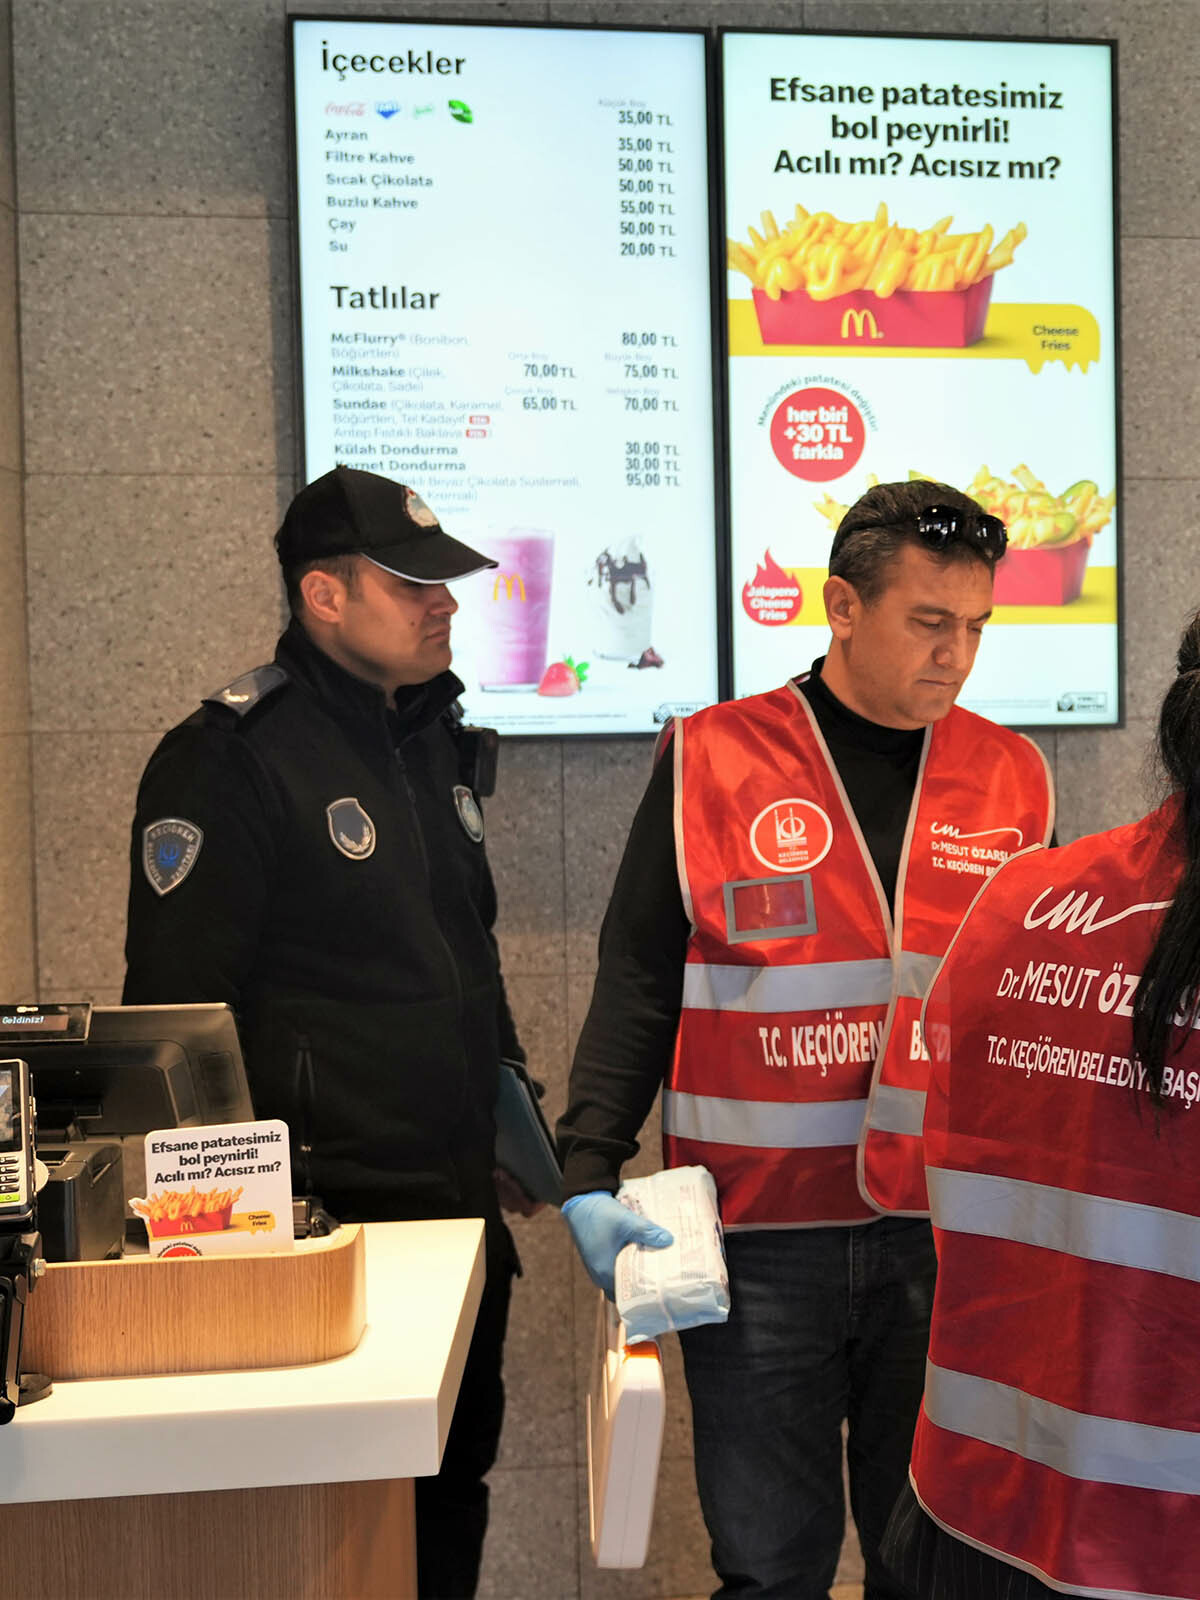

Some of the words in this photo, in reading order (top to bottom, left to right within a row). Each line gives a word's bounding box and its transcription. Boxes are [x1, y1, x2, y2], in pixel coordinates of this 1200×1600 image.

[321, 41, 466, 80] İçecekler
[770, 77, 875, 103] Efsane
[882, 81, 1064, 112] patatesimiz
[618, 110, 653, 127] 35,00
[657, 114, 673, 126] TL
[325, 129, 368, 143] Ayran
[831, 114, 878, 140] bol
[886, 116, 1010, 148] peynirli!
[618, 137, 653, 153] 35,00
[657, 141, 674, 153] TL
[326, 150, 366, 163] Filtre
[369, 151, 416, 164] Kahve
[774, 149, 841, 175] Acılı
[849, 152, 902, 176] mı?
[910, 154, 1001, 178] Acısız
[1008, 155, 1061, 180] mı?
[618, 158, 653, 174] 50,00
[658, 161, 674, 173] TL
[326, 173, 367, 186] Sıcak
[371, 173, 433, 190] Çikolata
[619, 178, 654, 195] 50,00
[658, 183, 675, 194] TL
[327, 196, 369, 208] Buzlu
[373, 196, 419, 209] Kahve
[620, 200, 655, 216] 55,00
[658, 204, 675, 215] TL
[328, 217, 356, 234] Çay
[620, 221, 655, 237] 50,00
[659, 224, 676, 236] TL
[329, 240, 348, 252] Su
[620, 242, 655, 258] 20,00
[660, 246, 677, 257] TL
[330, 285, 440, 311] Tatlılar
[1032, 325, 1079, 336] Cheese
[622, 332, 657, 348] 80,00
[661, 336, 678, 347] TL
[1041, 340, 1071, 351] Fries
[332, 366, 406, 378] Milkshake
[523, 363, 558, 379] 70,00
[559, 367, 577, 378] TL
[624, 364, 658, 380] 75,00
[662, 368, 680, 379] TL
[333, 398, 386, 410] Sundae
[522, 397, 557, 413] 65,00
[561, 400, 578, 411] TL
[624, 397, 658, 413] 70,00
[662, 400, 680, 411] TL
[786, 406, 817, 423] her
[818, 405, 848, 423] biri
[784, 424, 825, 443] +30
[825, 424, 854, 443] TL
[335, 443, 377, 455] Külah
[381, 444, 458, 456] Dondurma
[625, 441, 660, 457] 30,00
[664, 445, 680, 456] TL
[793, 443, 845, 460] farkla
[389, 460, 466, 472] Dondurma
[625, 457, 660, 473] 30,00
[664, 460, 681, 472] TL
[626, 473, 660, 489] 95,00
[664, 476, 681, 487] TL
[750, 597, 794, 609] Cheese
[759, 609, 788, 621] Fries
[947, 859, 985, 875] KEÇİÖREN
[996, 960, 1100, 1010] Dr.MESUT
[2, 1015, 45, 1024] Geldiniz!
[758, 1026, 788, 1067] T.C.
[791, 1011, 884, 1078] KEÇİÖREN
[987, 1035, 1008, 1066] T.C.
[1009, 1034, 1077, 1079] KEÇİÖREN
[1078, 1050, 1157, 1093] BELEDİY
[151, 1141, 199, 1154] Efsane
[201, 1131, 281, 1152] patatesimiz
[179, 1154, 201, 1166] bol
[204, 1147, 259, 1167] peynirli!
[154, 1170, 185, 1184] Acılı
[187, 1167, 212, 1181] mı?
[214, 1166, 255, 1178] Acısız
[257, 1160, 282, 1174] mı?
